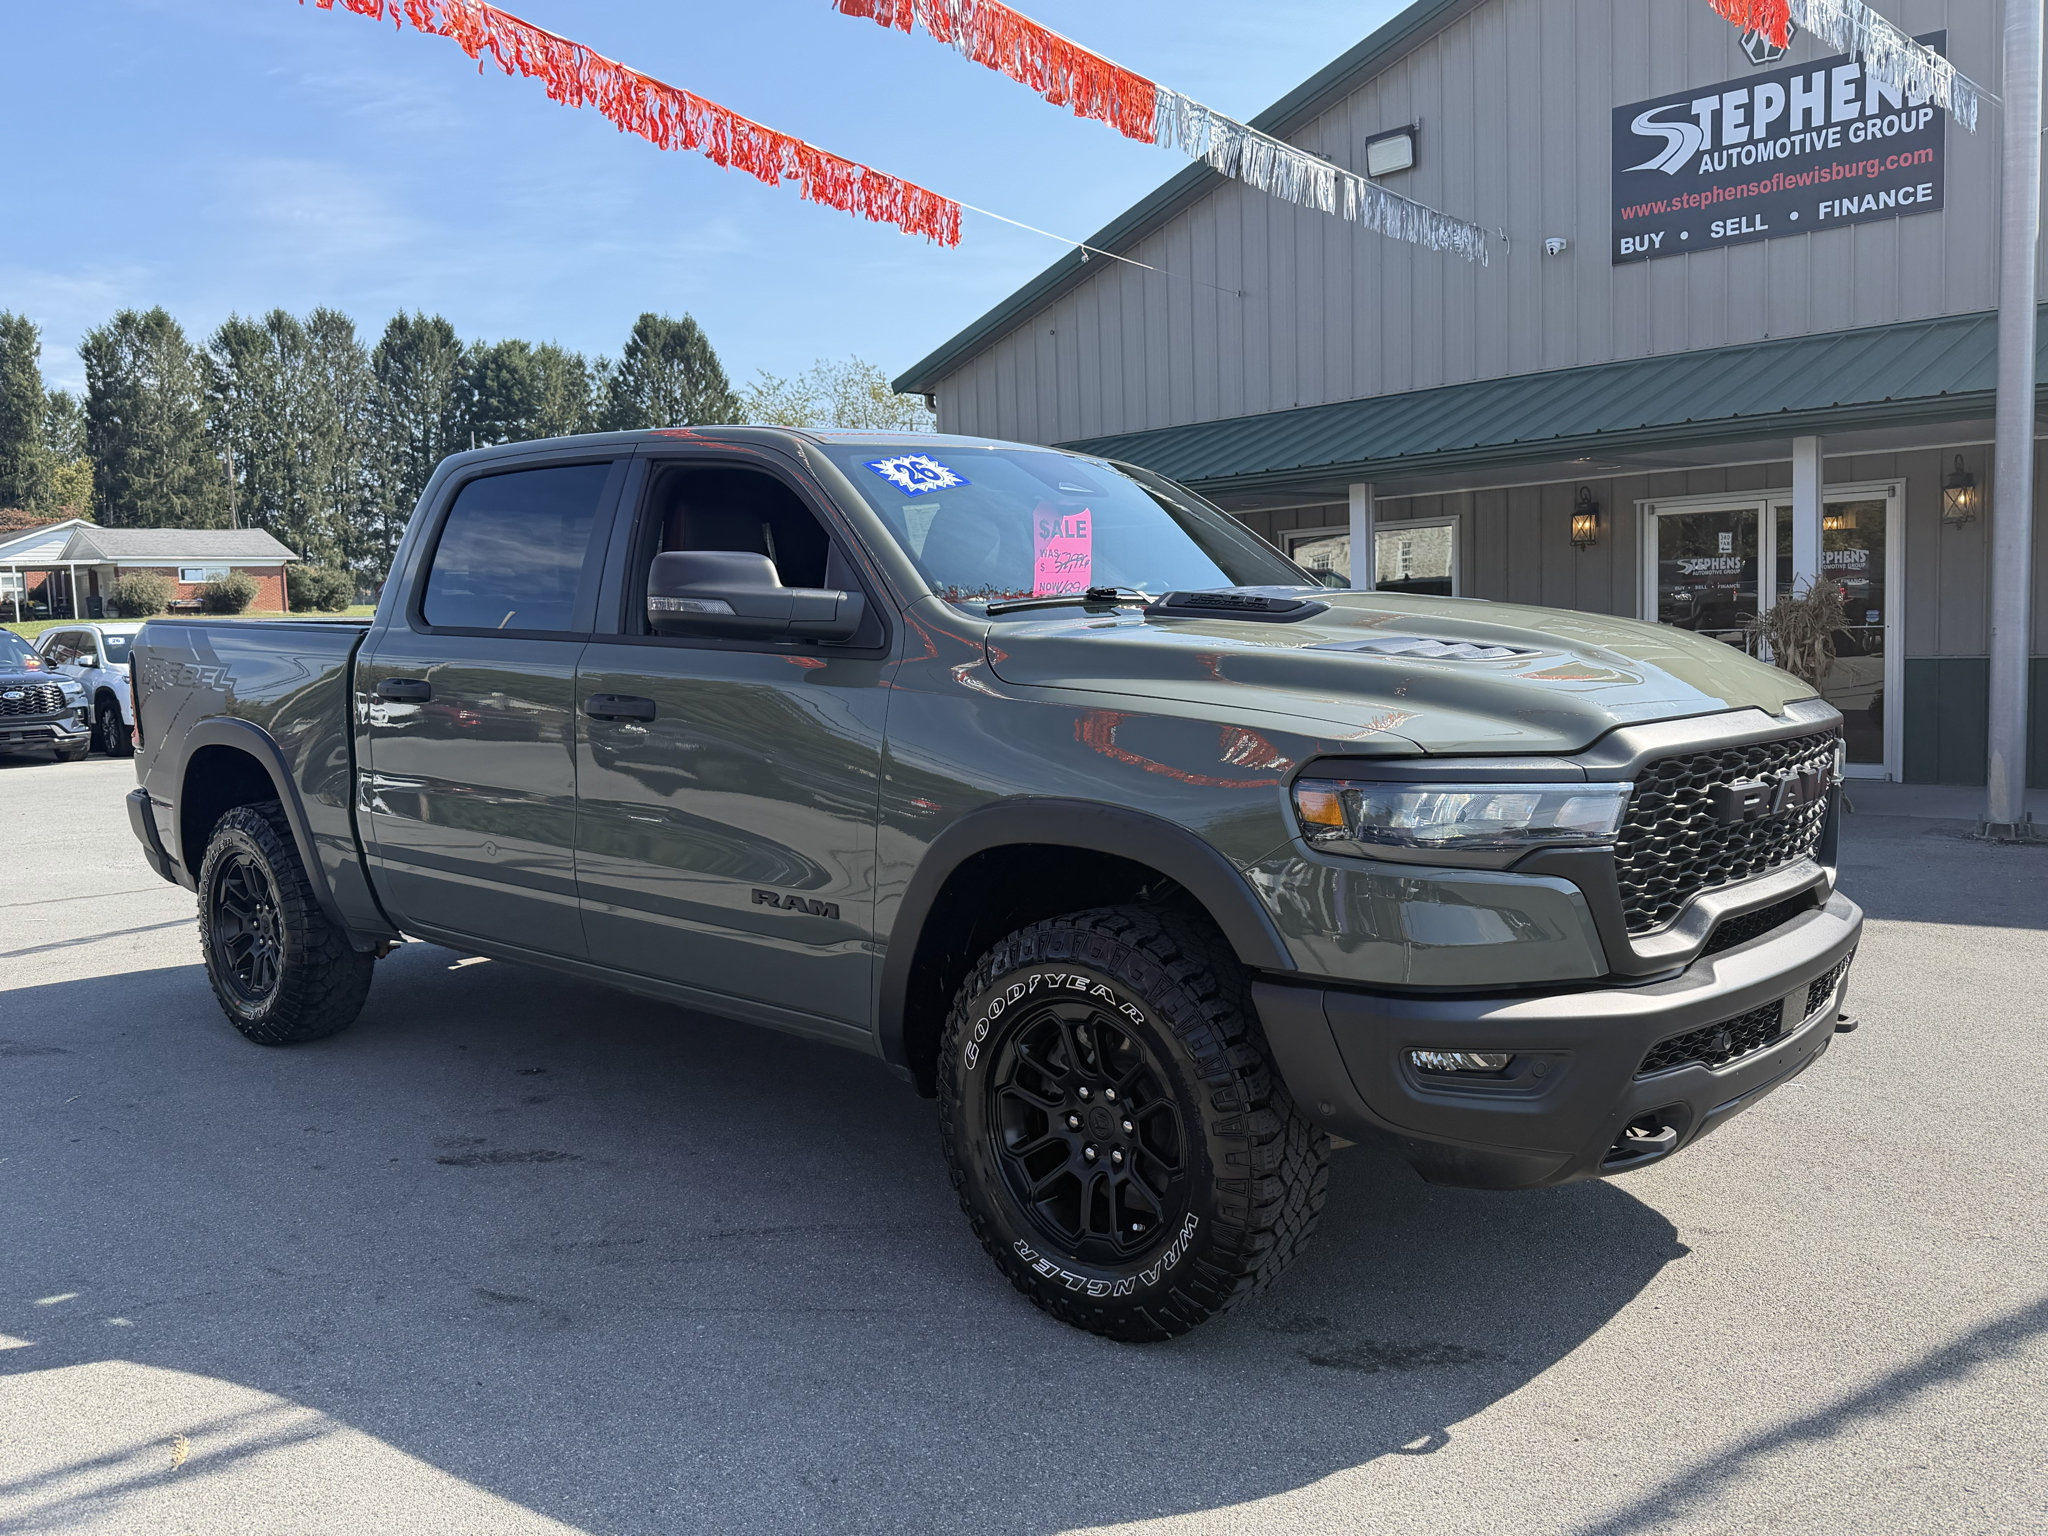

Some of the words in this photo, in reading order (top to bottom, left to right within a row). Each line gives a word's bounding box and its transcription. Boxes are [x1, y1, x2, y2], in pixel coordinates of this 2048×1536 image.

[1698, 126, 1842, 174] AUTOMOTIVE
[1849, 108, 1934, 144] GROUP
[1621, 147, 1934, 221] www.stephensoflewisburg.com
[1620, 231, 1665, 255] BUY
[1710, 213, 1769, 239] SELL
[1818, 183, 1934, 220] FINANCE
[893, 461, 942, 485] 26
[1039, 518, 1087, 539] SALE
[1040, 549, 1059, 558] WAS
[1040, 562, 1046, 572] $
[1676, 556, 1741, 575] STEPHENS
[1040, 582, 1059, 592] NOW
[142, 656, 238, 692] REBEL
[751, 888, 840, 920] RAM
[964, 973, 1145, 1070] GOODYEAR
[1013, 1212, 1199, 1297] WRANGLER
